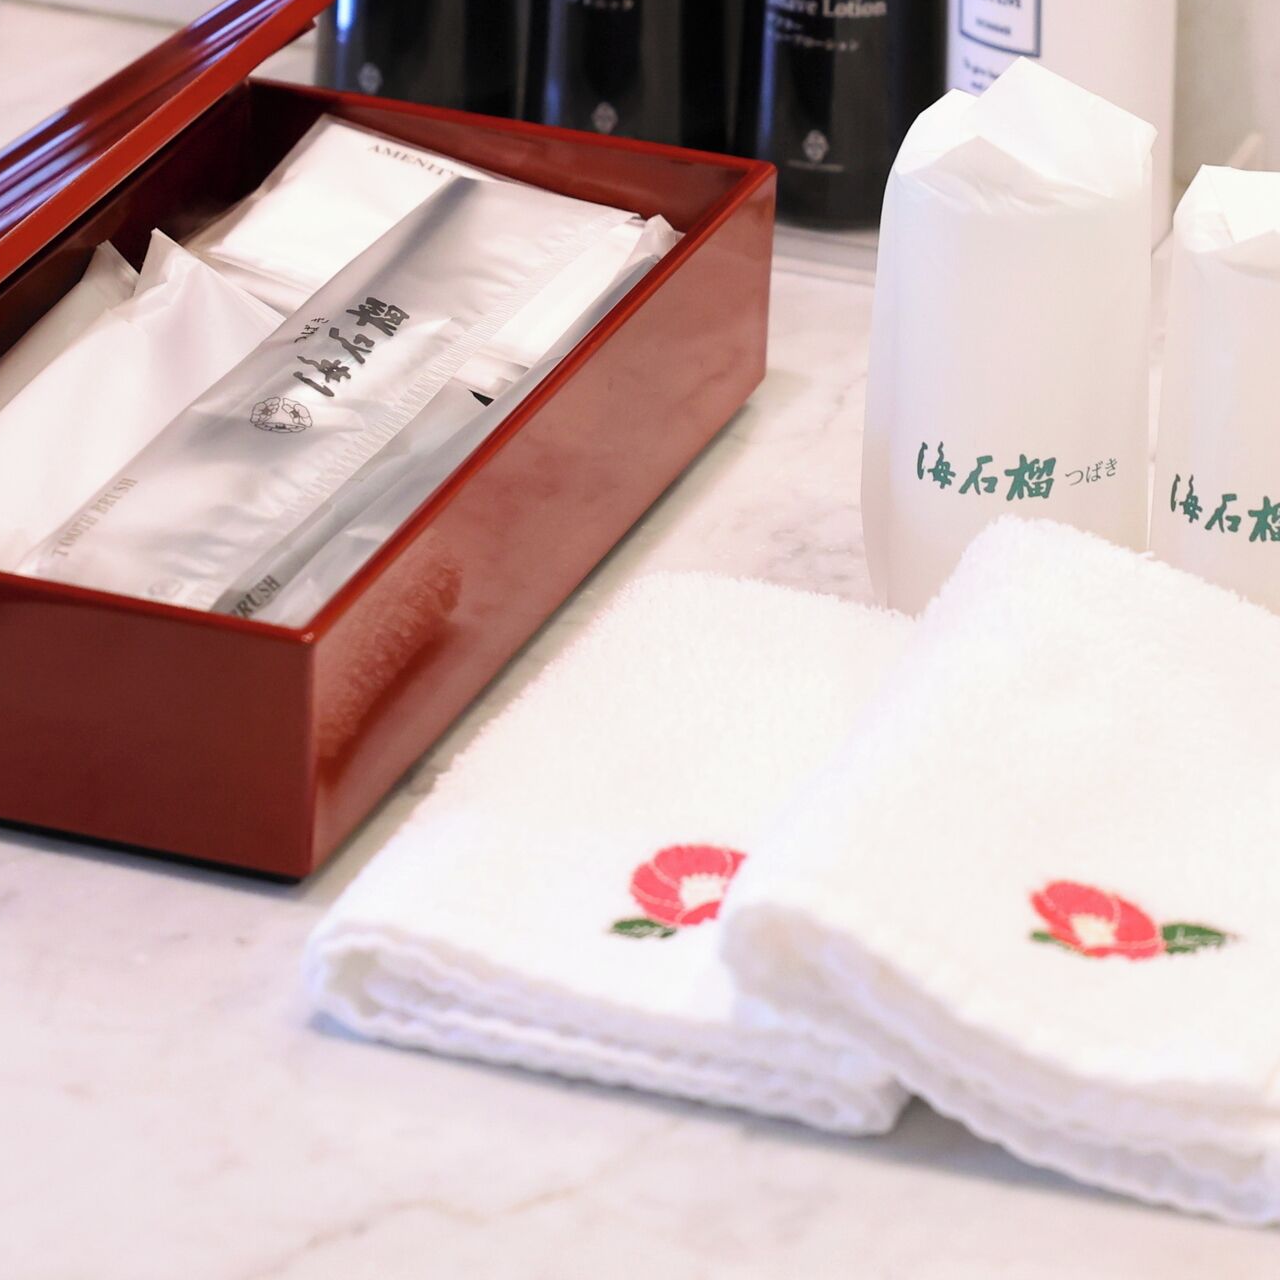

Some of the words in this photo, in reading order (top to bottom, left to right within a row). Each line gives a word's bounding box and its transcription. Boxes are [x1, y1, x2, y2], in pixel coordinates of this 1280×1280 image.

[292, 296, 411, 398] 海石榴
[293, 317, 330, 343] つばき
[916, 441, 1057, 501] 海石榴
[1064, 457, 1119, 487] つばき
[51, 513, 97, 557] TOOTH
[92, 477, 138, 514] BRUSH
